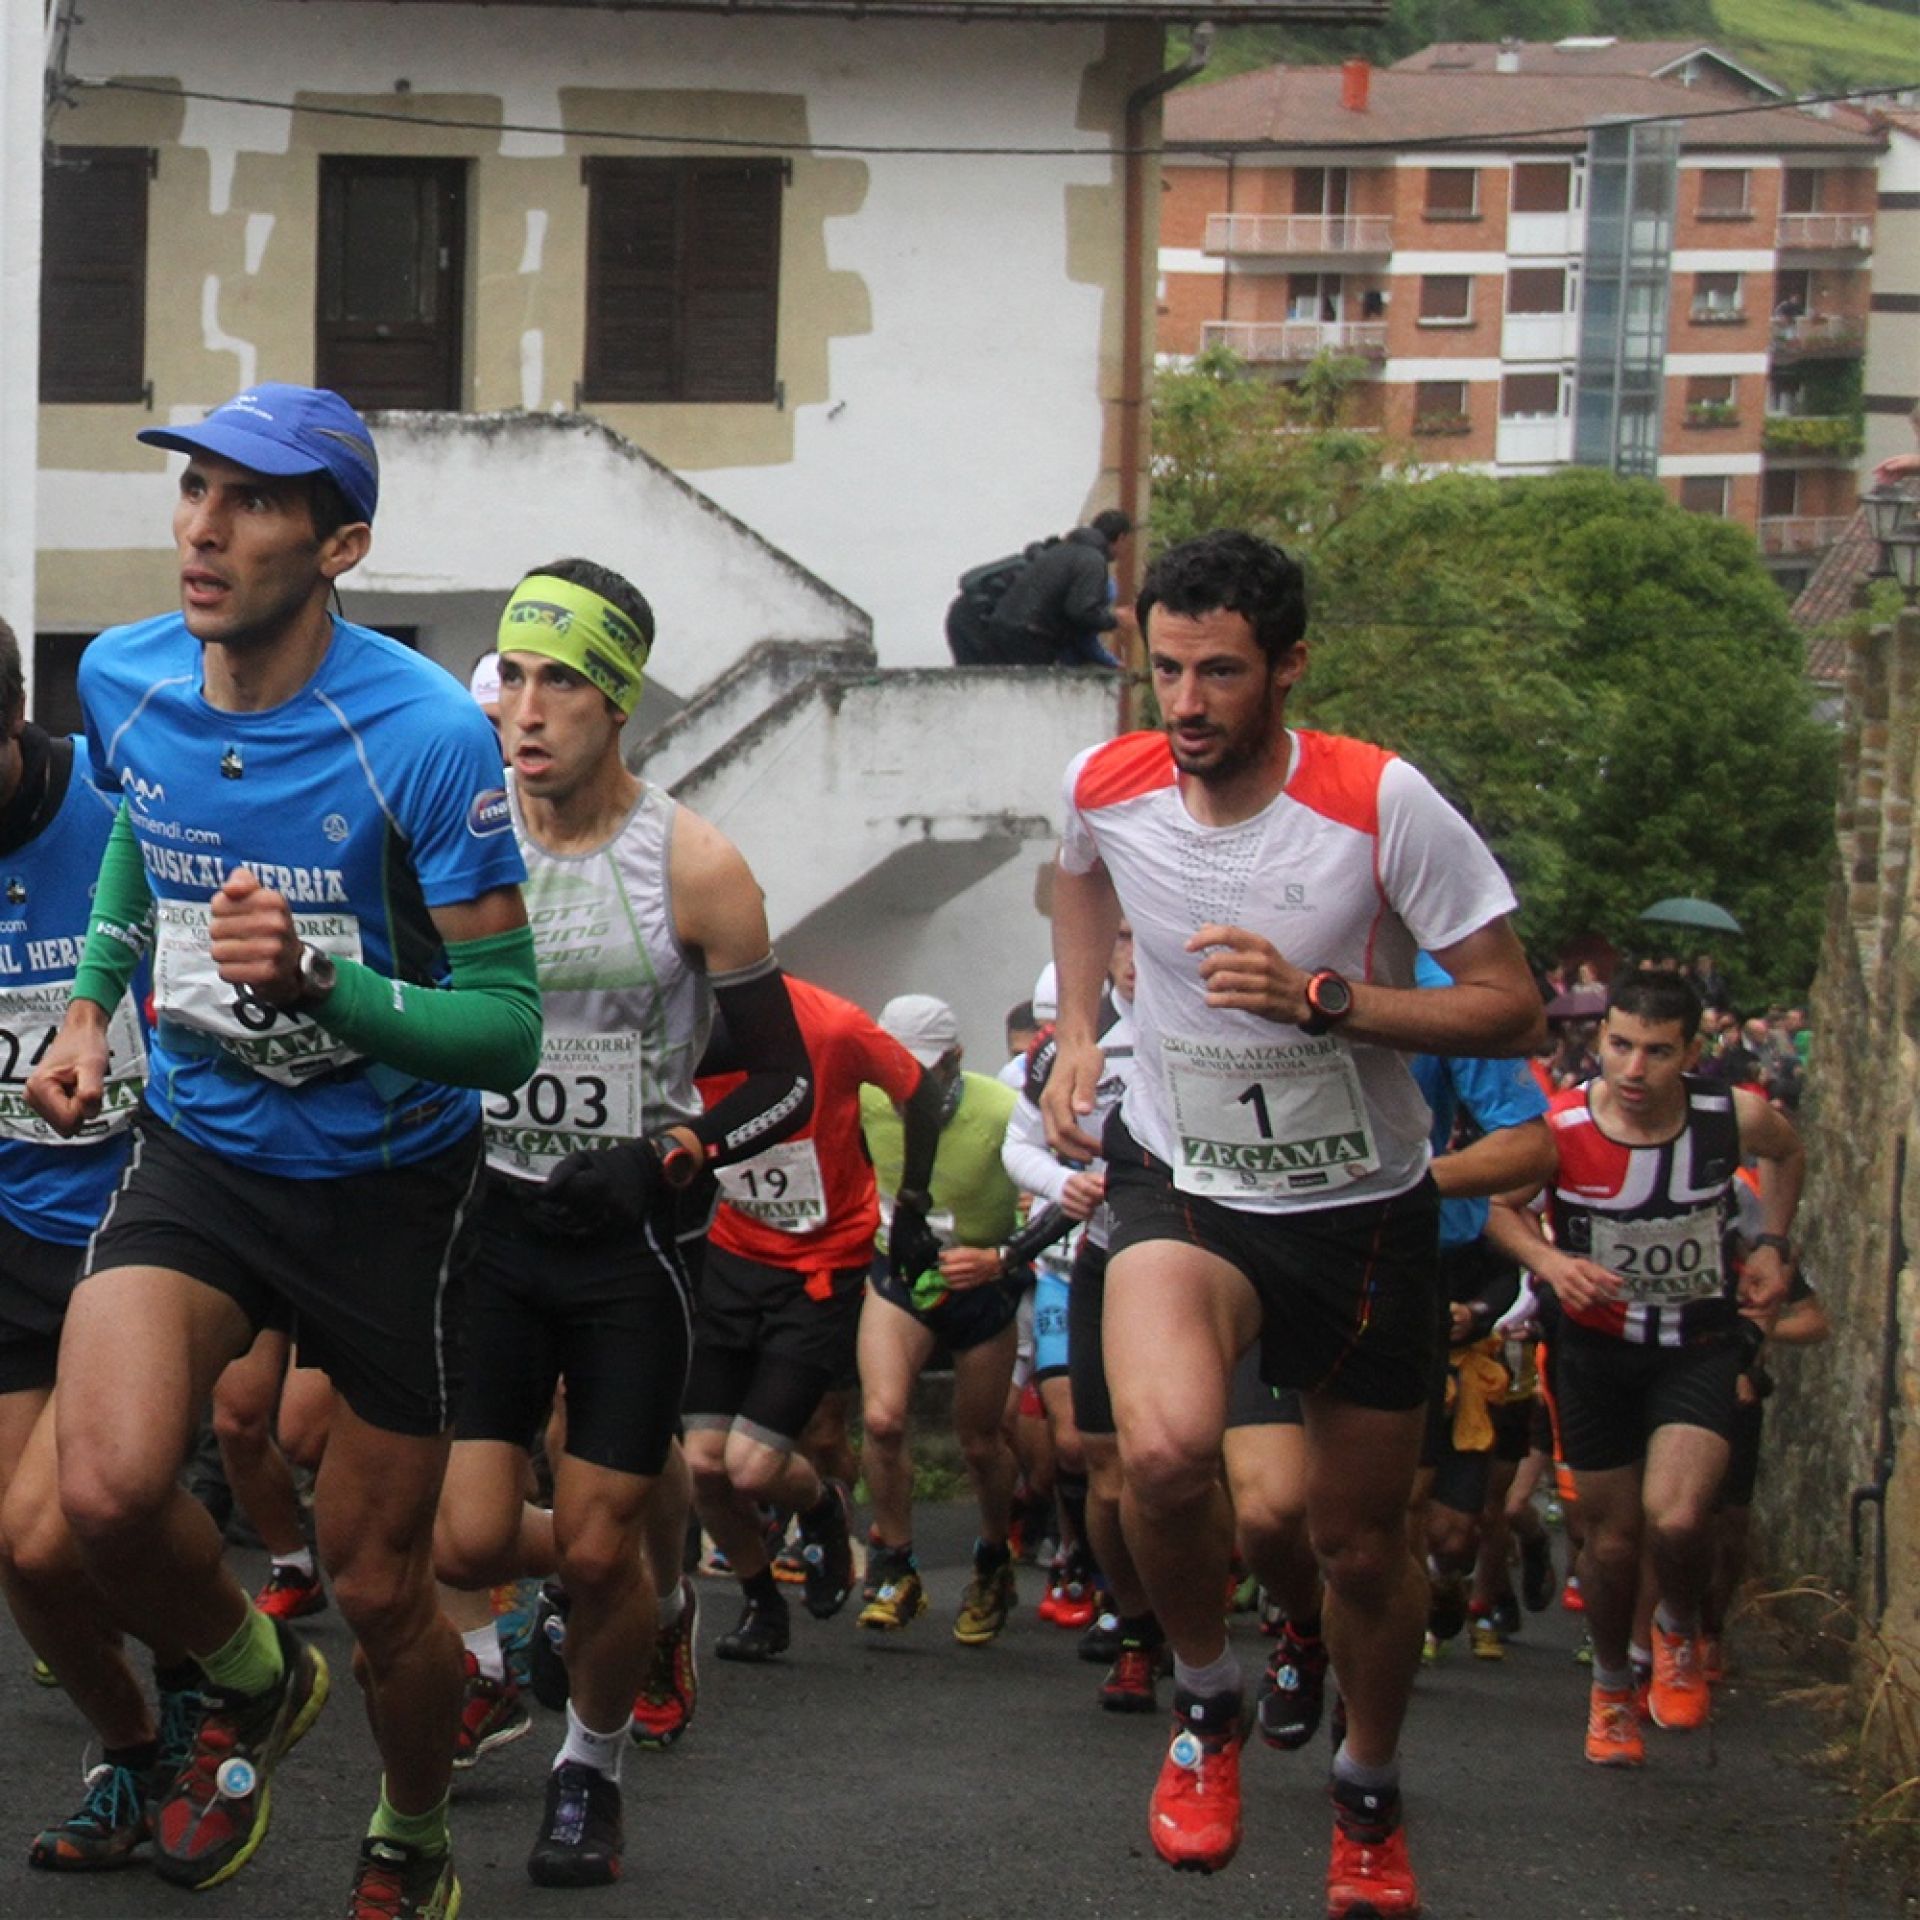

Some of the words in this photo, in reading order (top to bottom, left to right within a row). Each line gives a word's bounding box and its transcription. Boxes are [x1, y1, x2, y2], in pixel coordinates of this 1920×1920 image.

[543, 1036, 632, 1053] AIZKORRI
[1238, 1082, 1273, 1139] 1
[1187, 1136, 1362, 1170] ZEGAMA
[740, 1168, 788, 1199] 19
[1612, 1238, 1702, 1276] 200
